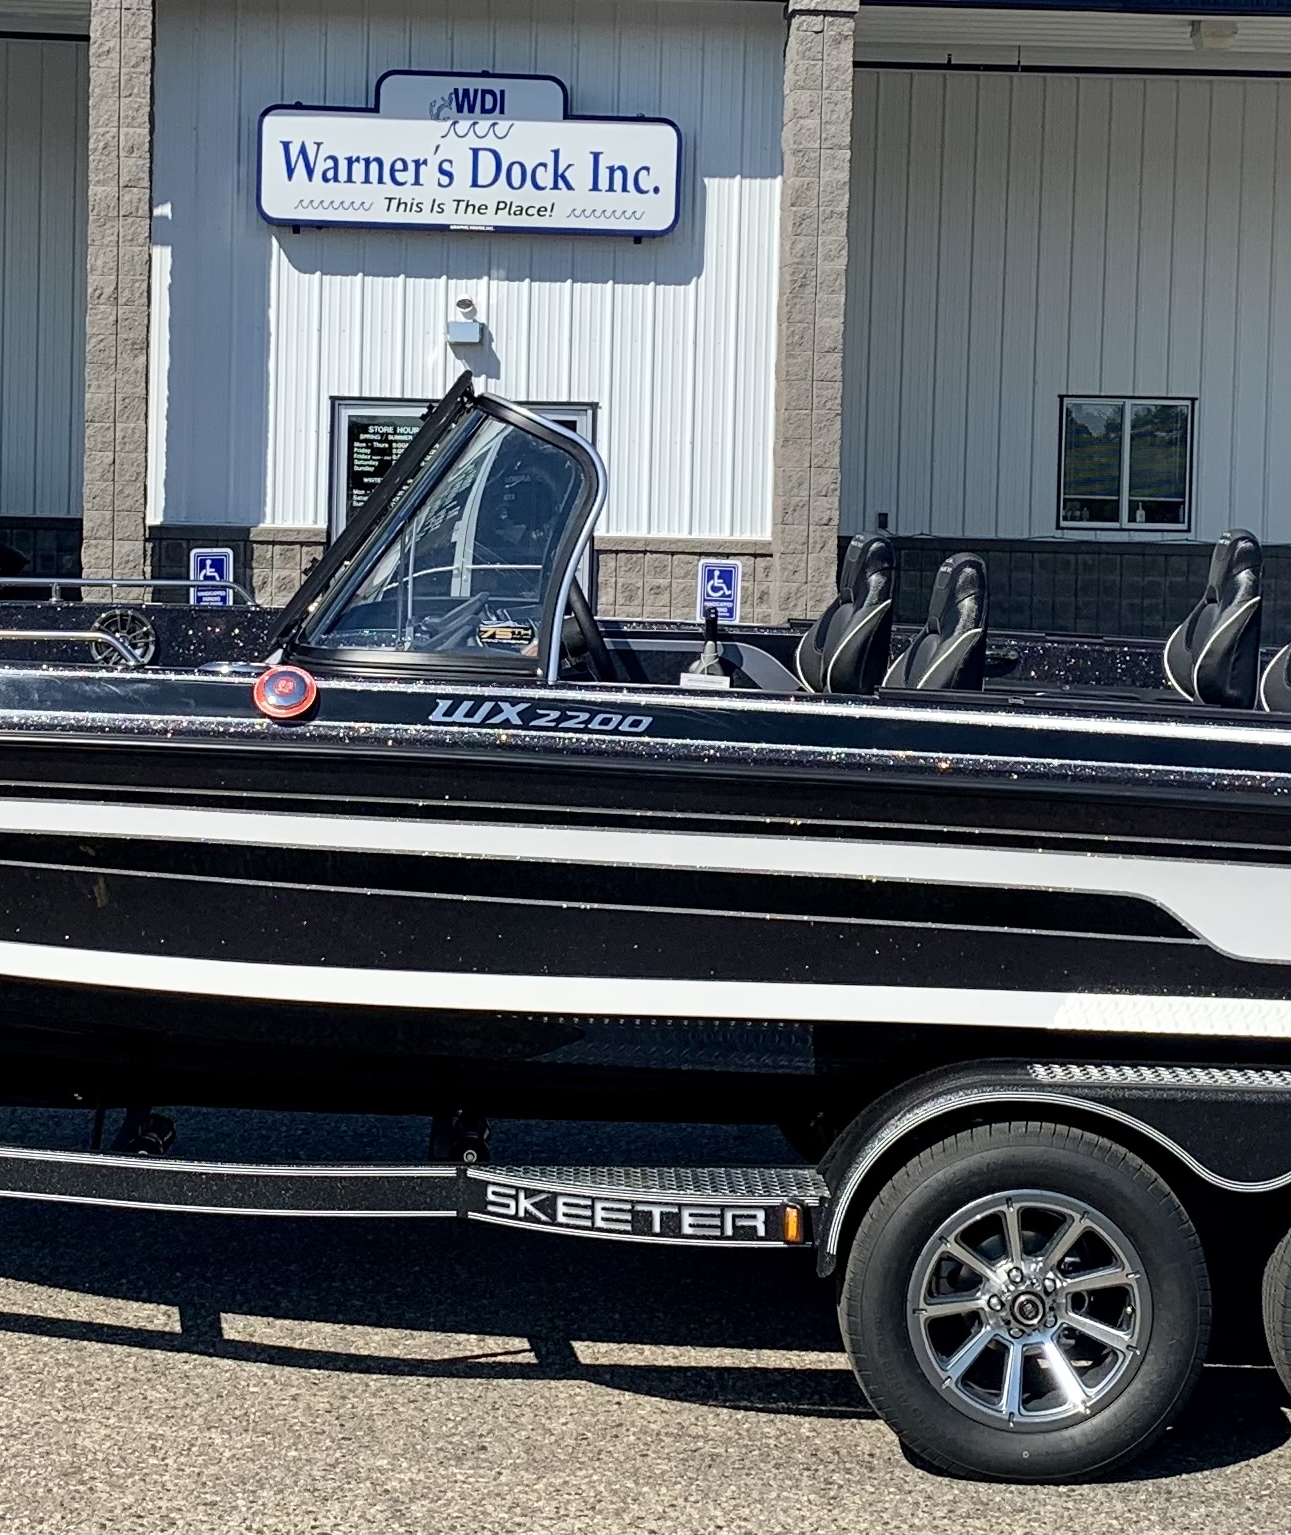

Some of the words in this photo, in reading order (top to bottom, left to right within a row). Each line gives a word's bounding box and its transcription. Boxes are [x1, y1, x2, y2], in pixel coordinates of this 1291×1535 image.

[453, 88, 506, 115] WDI
[280, 139, 455, 188] Warner's
[469, 147, 576, 192] Dock
[588, 151, 662, 196] Inc.
[384, 196, 426, 215] This
[429, 198, 446, 215] Is
[452, 199, 490, 217] The
[494, 200, 555, 219] Place!
[368, 425, 394, 434] STORE
[397, 426, 420, 434] HOUR
[486, 1184, 767, 1238] SKEETER
